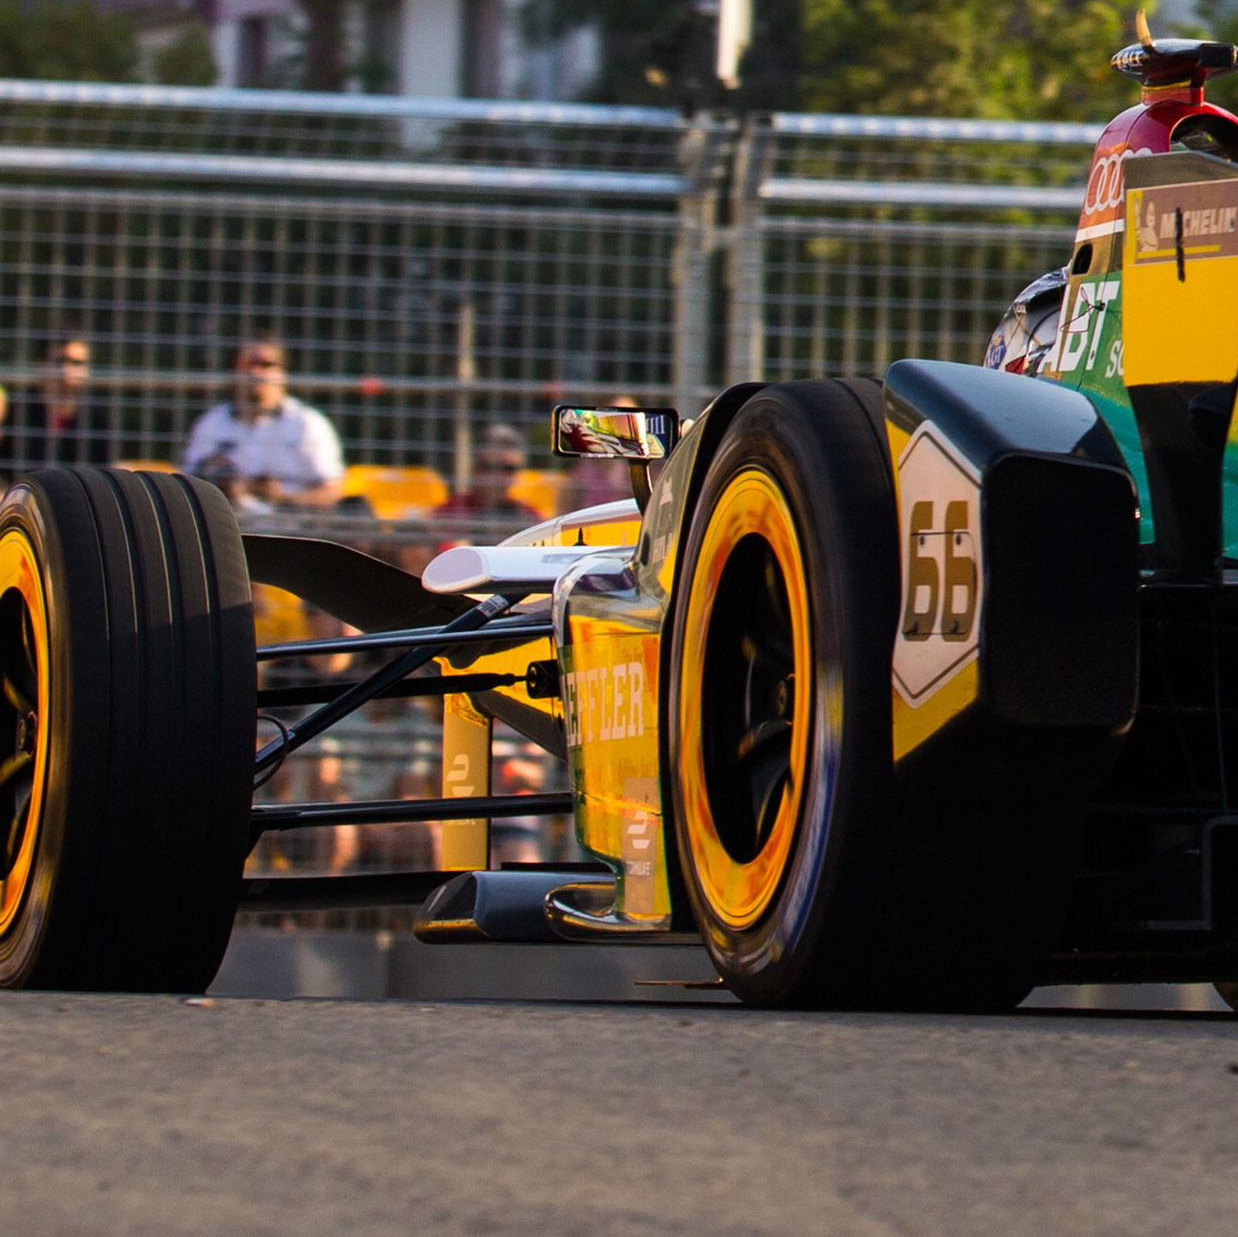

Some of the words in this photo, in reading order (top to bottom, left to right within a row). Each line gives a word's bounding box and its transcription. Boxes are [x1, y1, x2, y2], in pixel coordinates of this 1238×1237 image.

[1160, 207, 1237, 239] MCHELIN
[1037, 280, 1120, 374] ABT
[902, 500, 977, 642] 66
